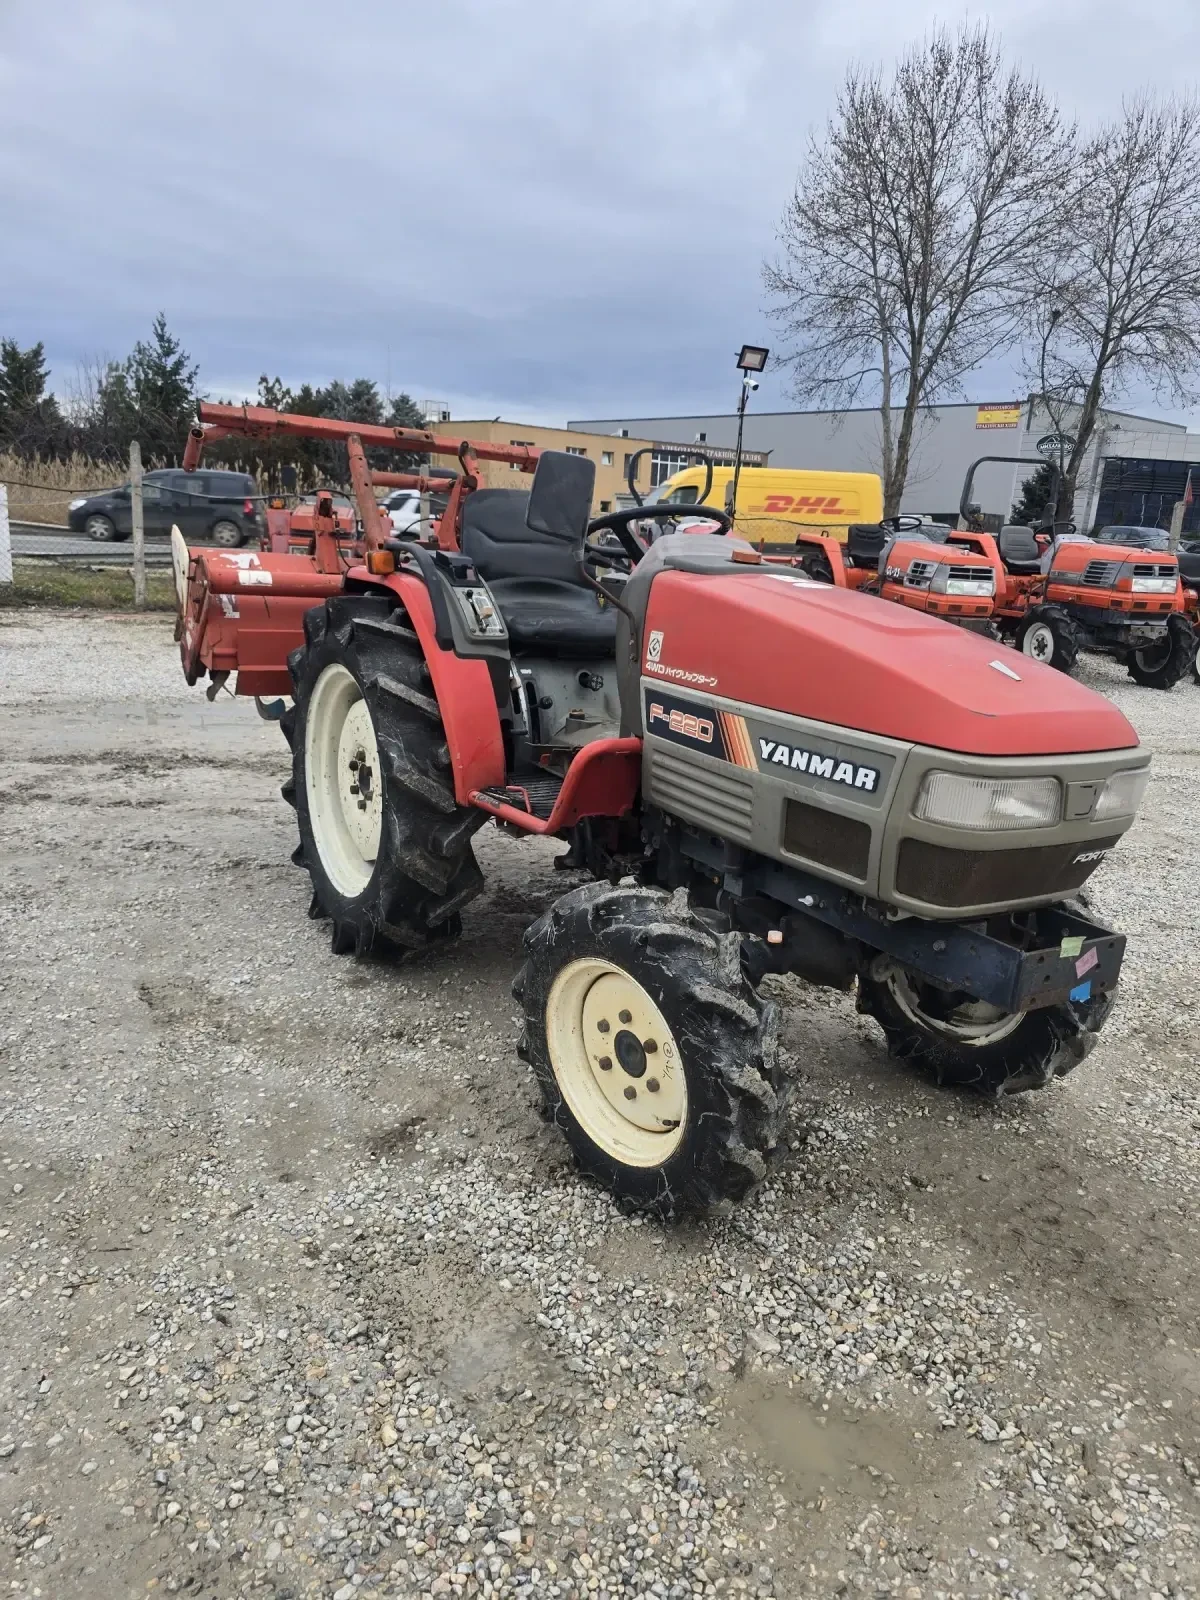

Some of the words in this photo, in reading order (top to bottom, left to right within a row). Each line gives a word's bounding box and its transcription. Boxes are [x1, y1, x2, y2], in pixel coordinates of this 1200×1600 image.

[706, 449, 745, 461] ТРАКИЙСИ
[763, 495, 845, 515] DHL
[645, 661, 665, 675] 4WD
[665, 667, 718, 687] ハイグリップターン
[649, 703, 714, 743] F-220
[758, 738, 878, 791] YANMAR
